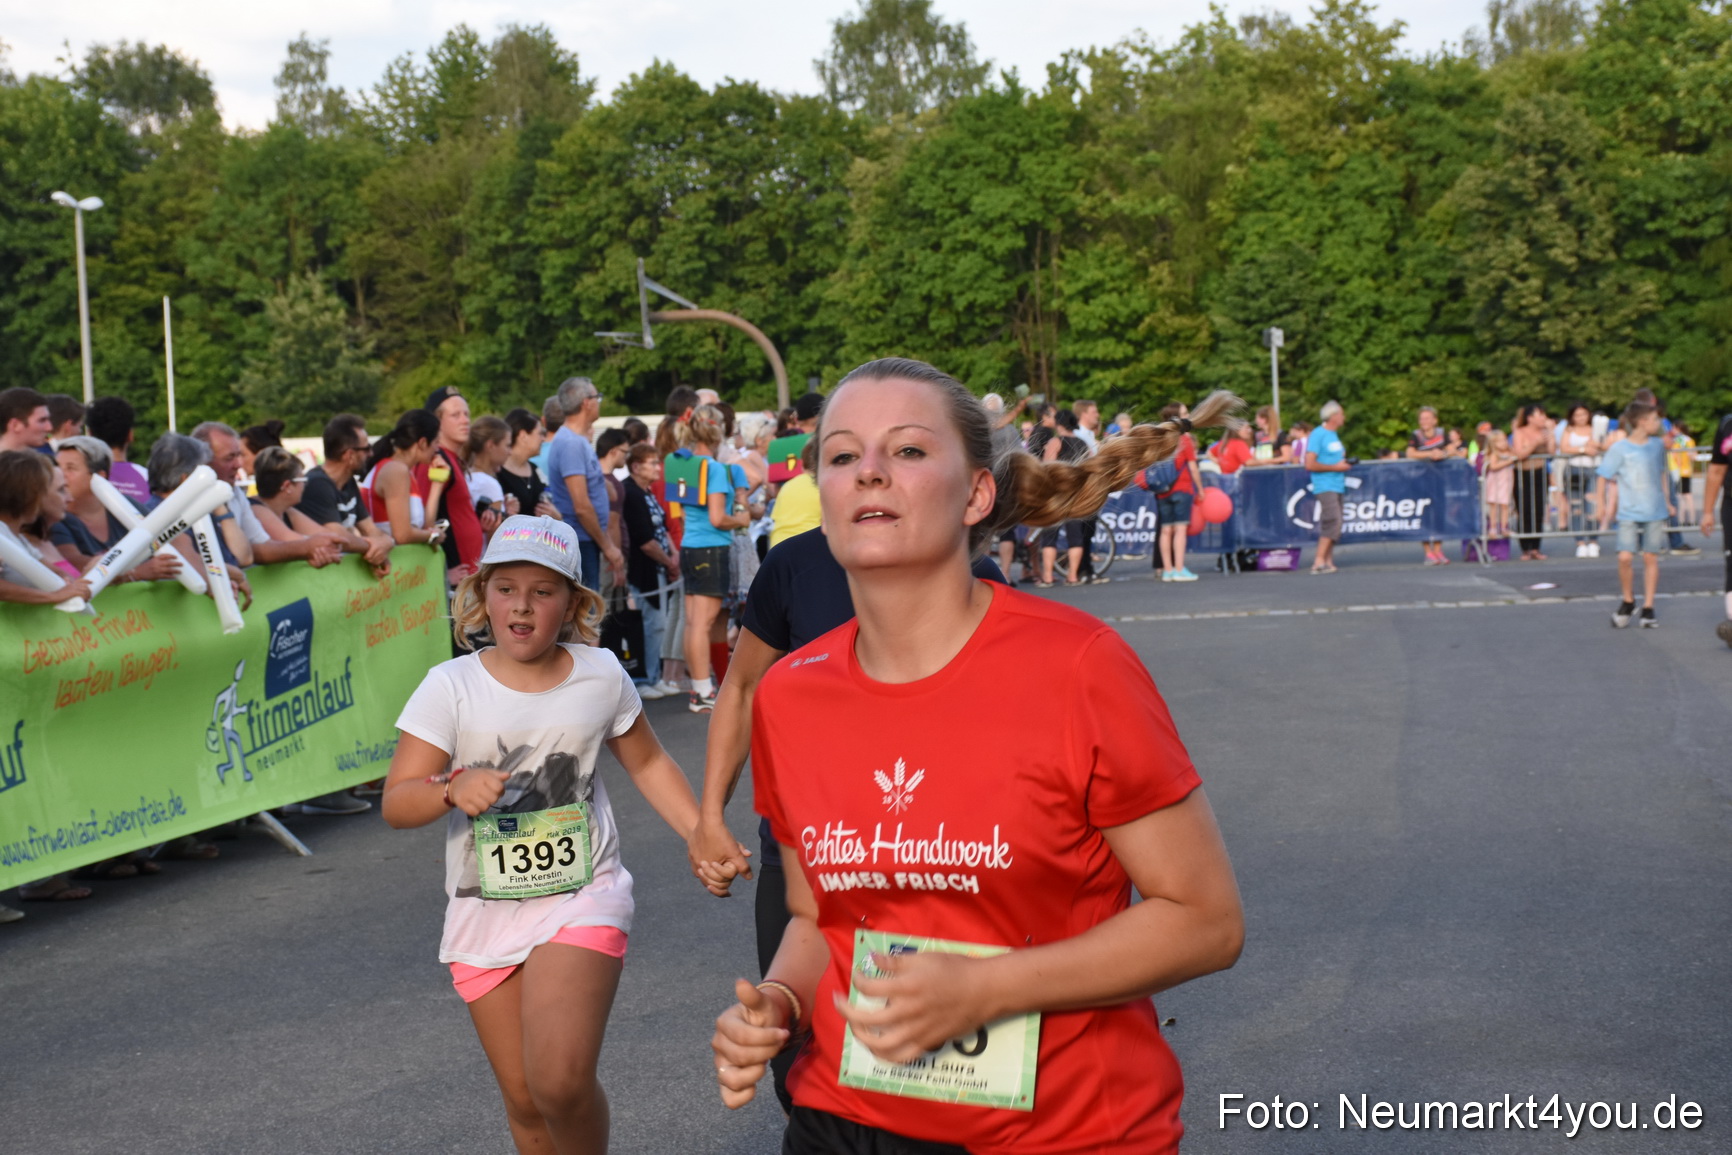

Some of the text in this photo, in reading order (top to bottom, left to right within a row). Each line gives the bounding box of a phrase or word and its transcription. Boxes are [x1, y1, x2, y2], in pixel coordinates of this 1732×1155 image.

[501, 527, 569, 555] NEW YORK
[23, 609, 154, 674] Gesunde Firmen
[55, 632, 180, 710] laufen länger!
[802, 653, 830, 665] JAKO
[246, 655, 354, 752] firmenlauf
[256, 737, 305, 772] neumarkt
[491, 836, 576, 874] 1393
[801, 820, 1014, 870] Echtes Handwerk
[509, 870, 563, 883] Fink Kerstin
[533, 878, 562, 889] Neumarkt
[818, 871, 980, 894] IMMER FRISCH
[932, 1056, 975, 1075] Laura
